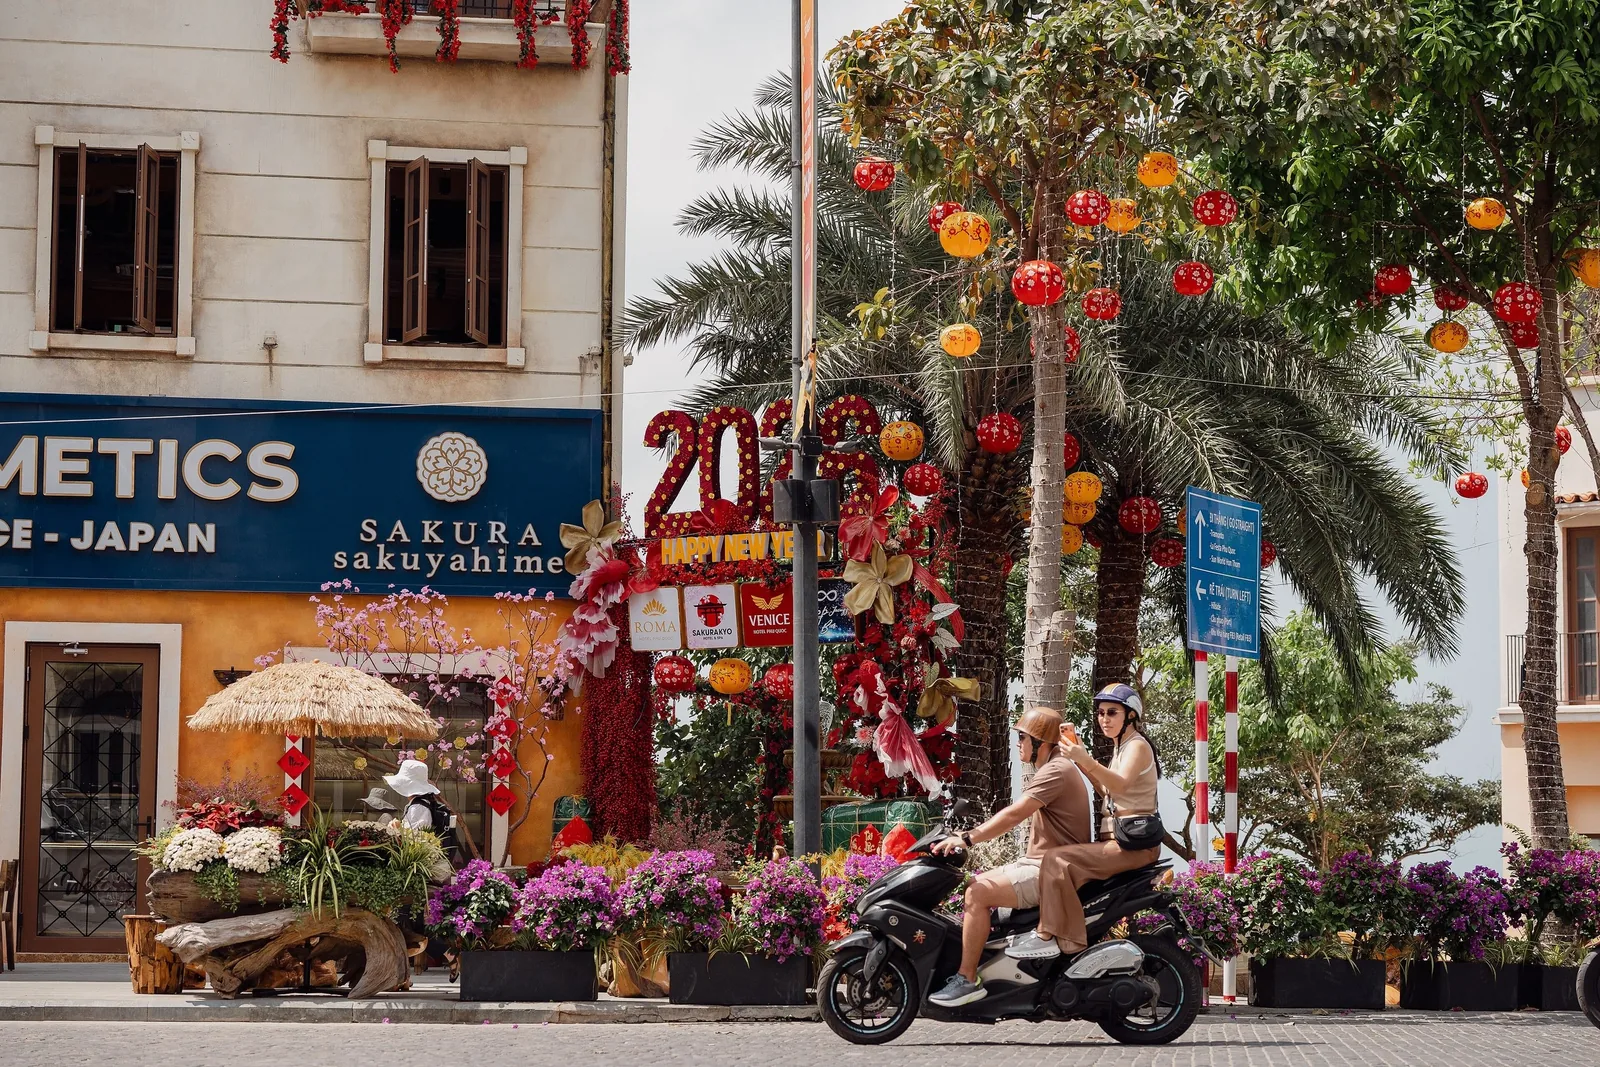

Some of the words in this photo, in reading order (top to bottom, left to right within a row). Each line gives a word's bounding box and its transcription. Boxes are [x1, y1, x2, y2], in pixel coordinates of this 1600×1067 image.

[70, 520, 215, 552] JAPAN
[360, 519, 542, 546] SAKURA
[333, 544, 564, 578] sakuyahime
[661, 535, 724, 565] HAPPY
[725, 532, 770, 561] NEW
[770, 530, 825, 558] YE
[634, 621, 676, 633] ROMA
[692, 628, 732, 637] SAKURAKYO
[749, 613, 791, 626] VENICE
